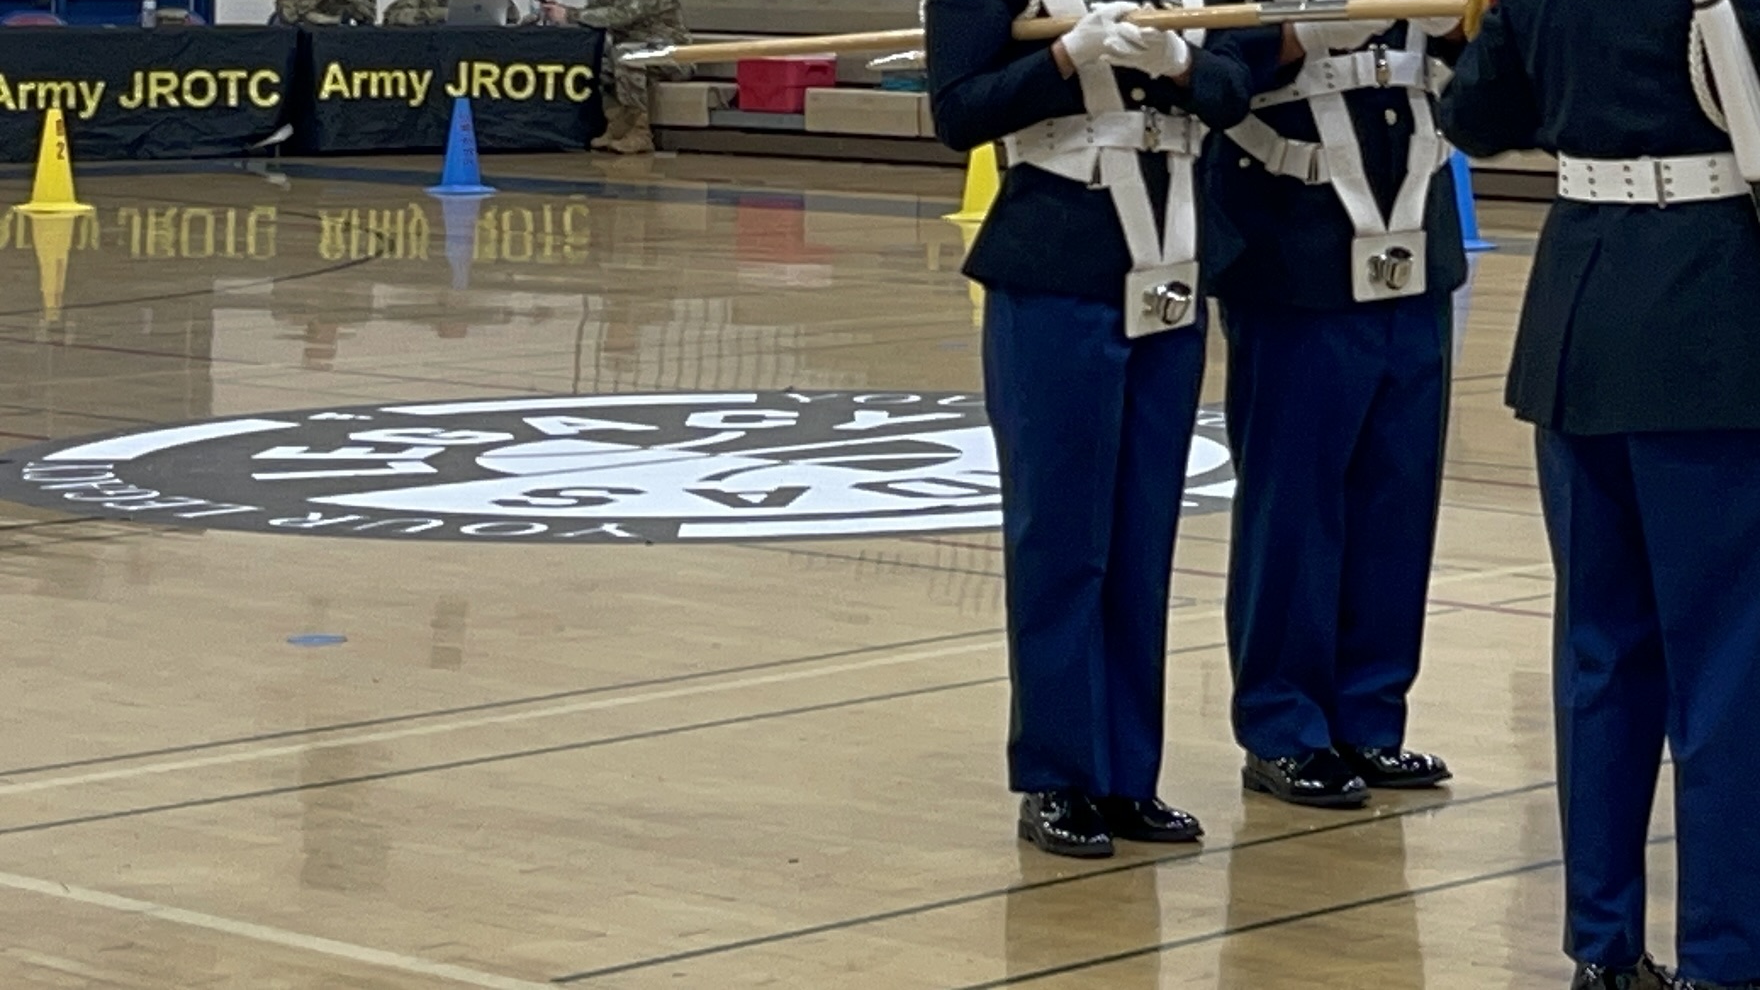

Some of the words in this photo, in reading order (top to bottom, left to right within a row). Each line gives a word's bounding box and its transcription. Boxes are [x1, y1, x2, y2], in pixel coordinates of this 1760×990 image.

[0, 71, 106, 119] Army
[118, 69, 281, 108] JROTC
[318, 62, 433, 107] Army
[445, 61, 594, 101] JROTC
